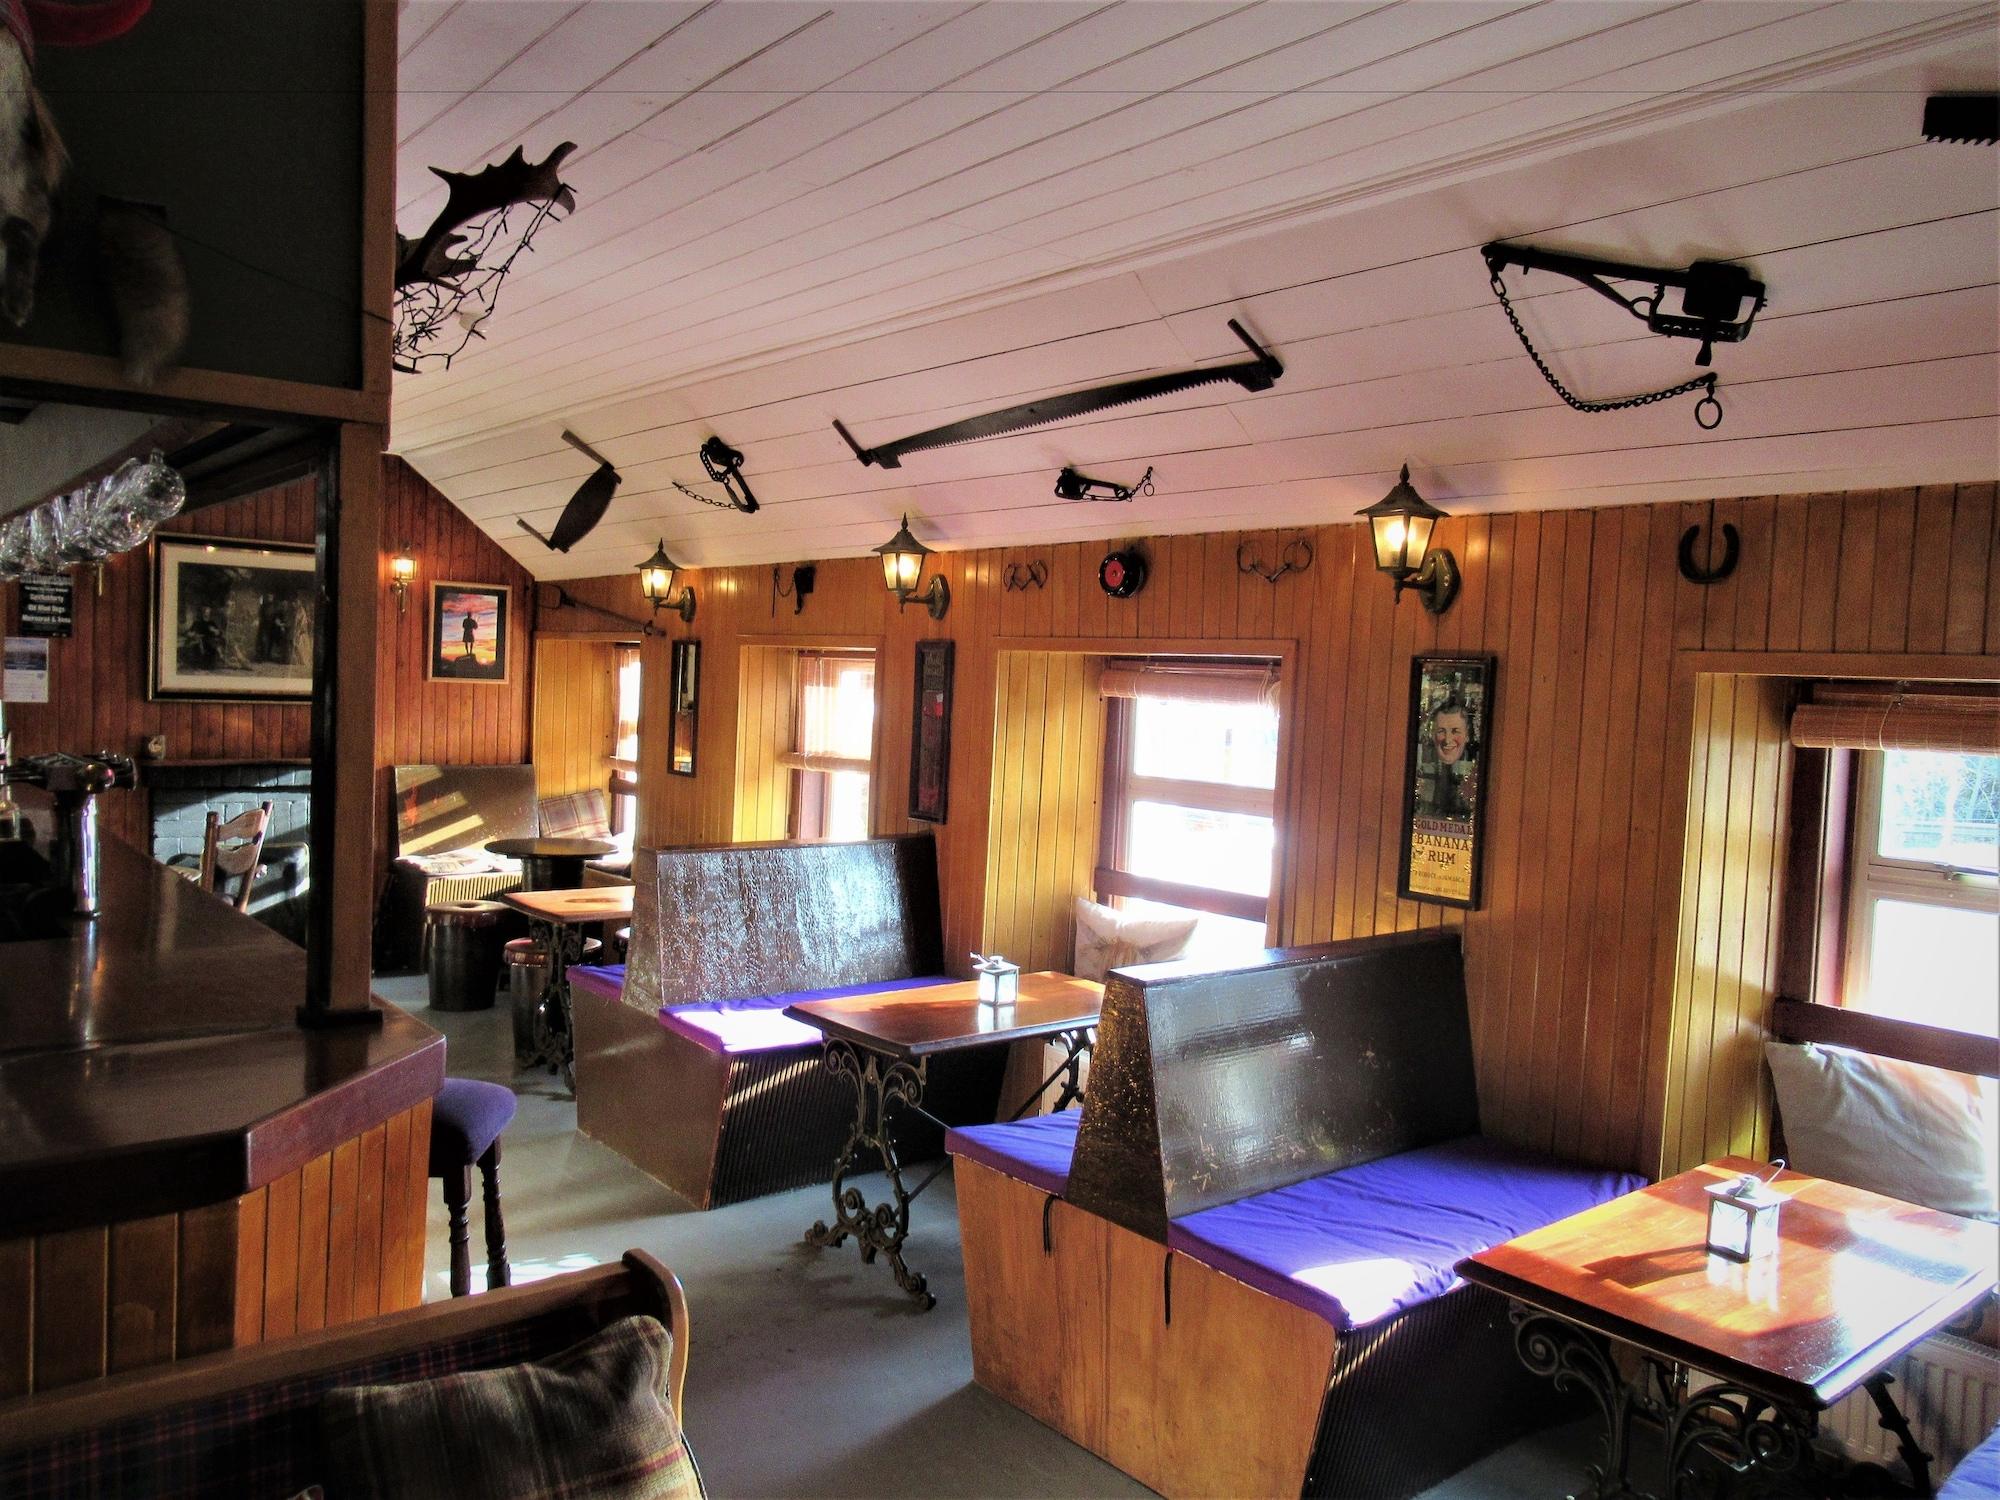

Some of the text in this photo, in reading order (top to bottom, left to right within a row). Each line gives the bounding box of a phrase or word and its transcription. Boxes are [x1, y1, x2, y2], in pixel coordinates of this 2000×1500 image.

[1439, 822, 1473, 835] MEDAL
[1416, 833, 1470, 851] BANANA
[1428, 850, 1456, 865] RUM
